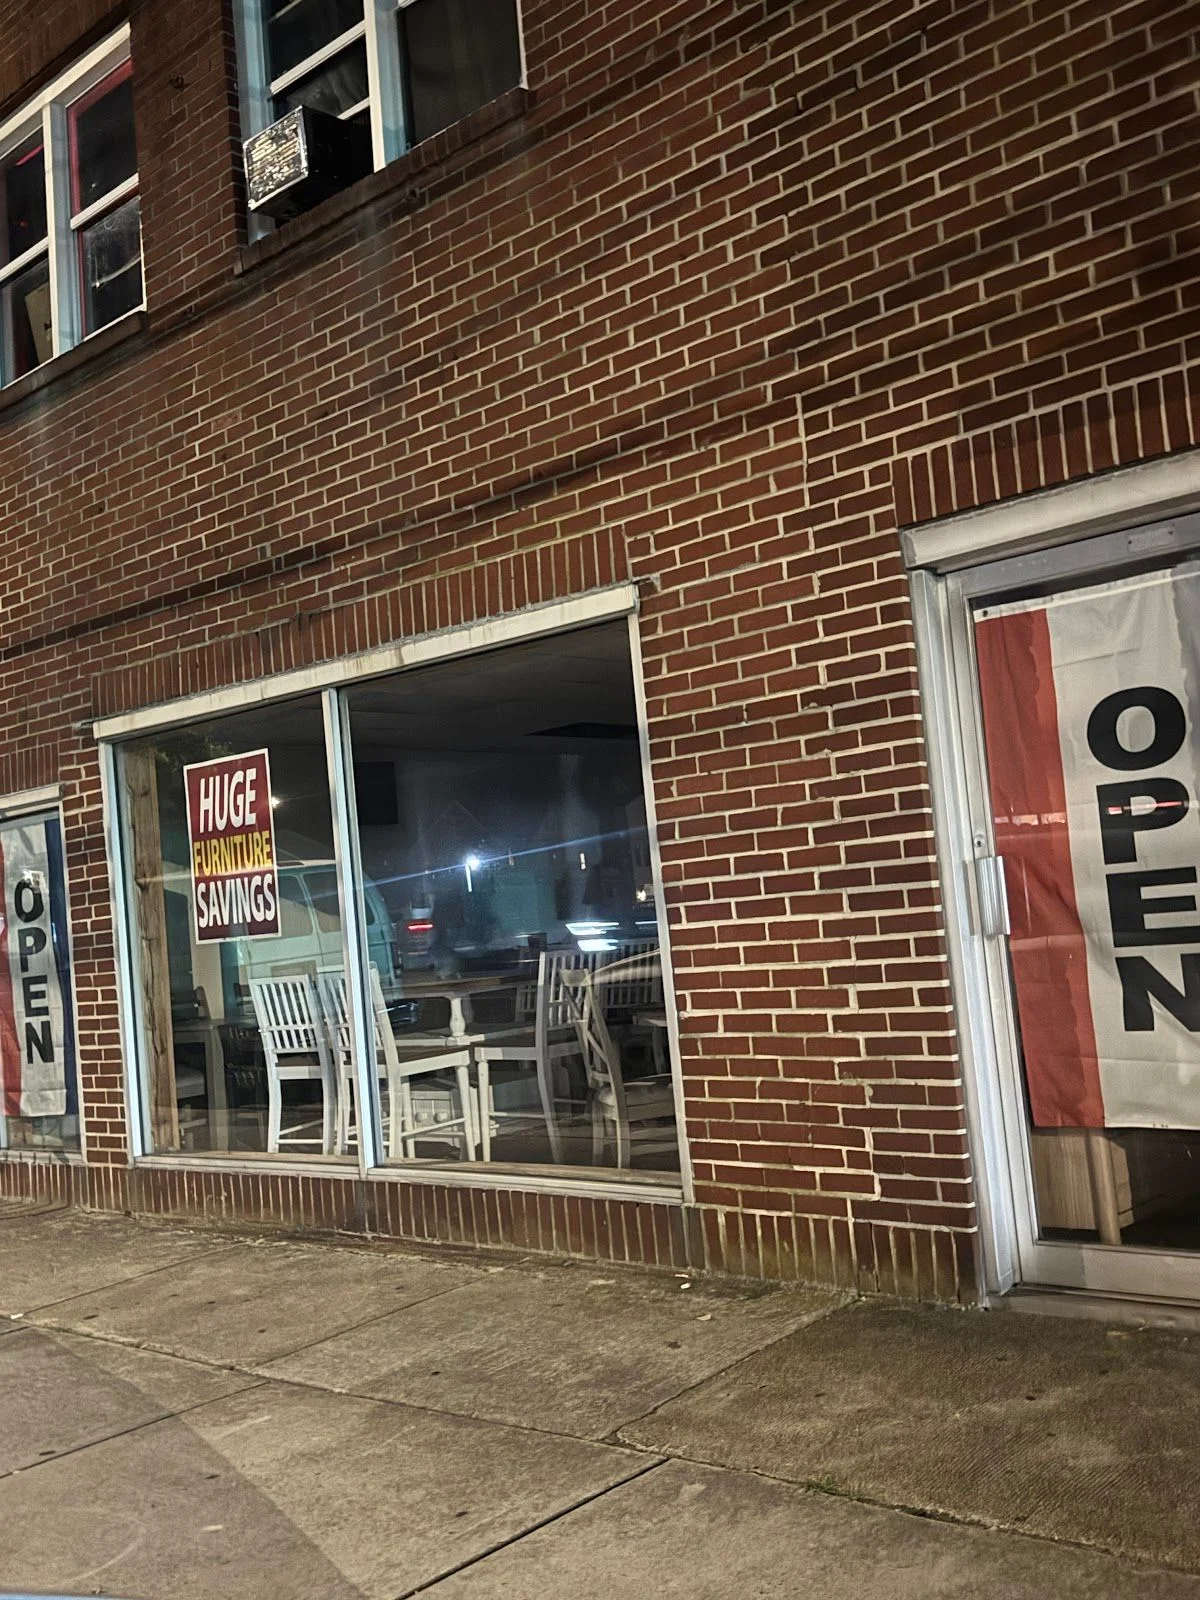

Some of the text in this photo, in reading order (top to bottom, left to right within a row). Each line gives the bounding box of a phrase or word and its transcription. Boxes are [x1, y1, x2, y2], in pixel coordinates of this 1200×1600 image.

[199, 767, 257, 834] HUGE
[192, 829, 273, 877] FURNITURE
[1086, 686, 1200, 1033] OPEN
[197, 873, 276, 928] SAVINGS
[14, 878, 55, 1064] OPEN
